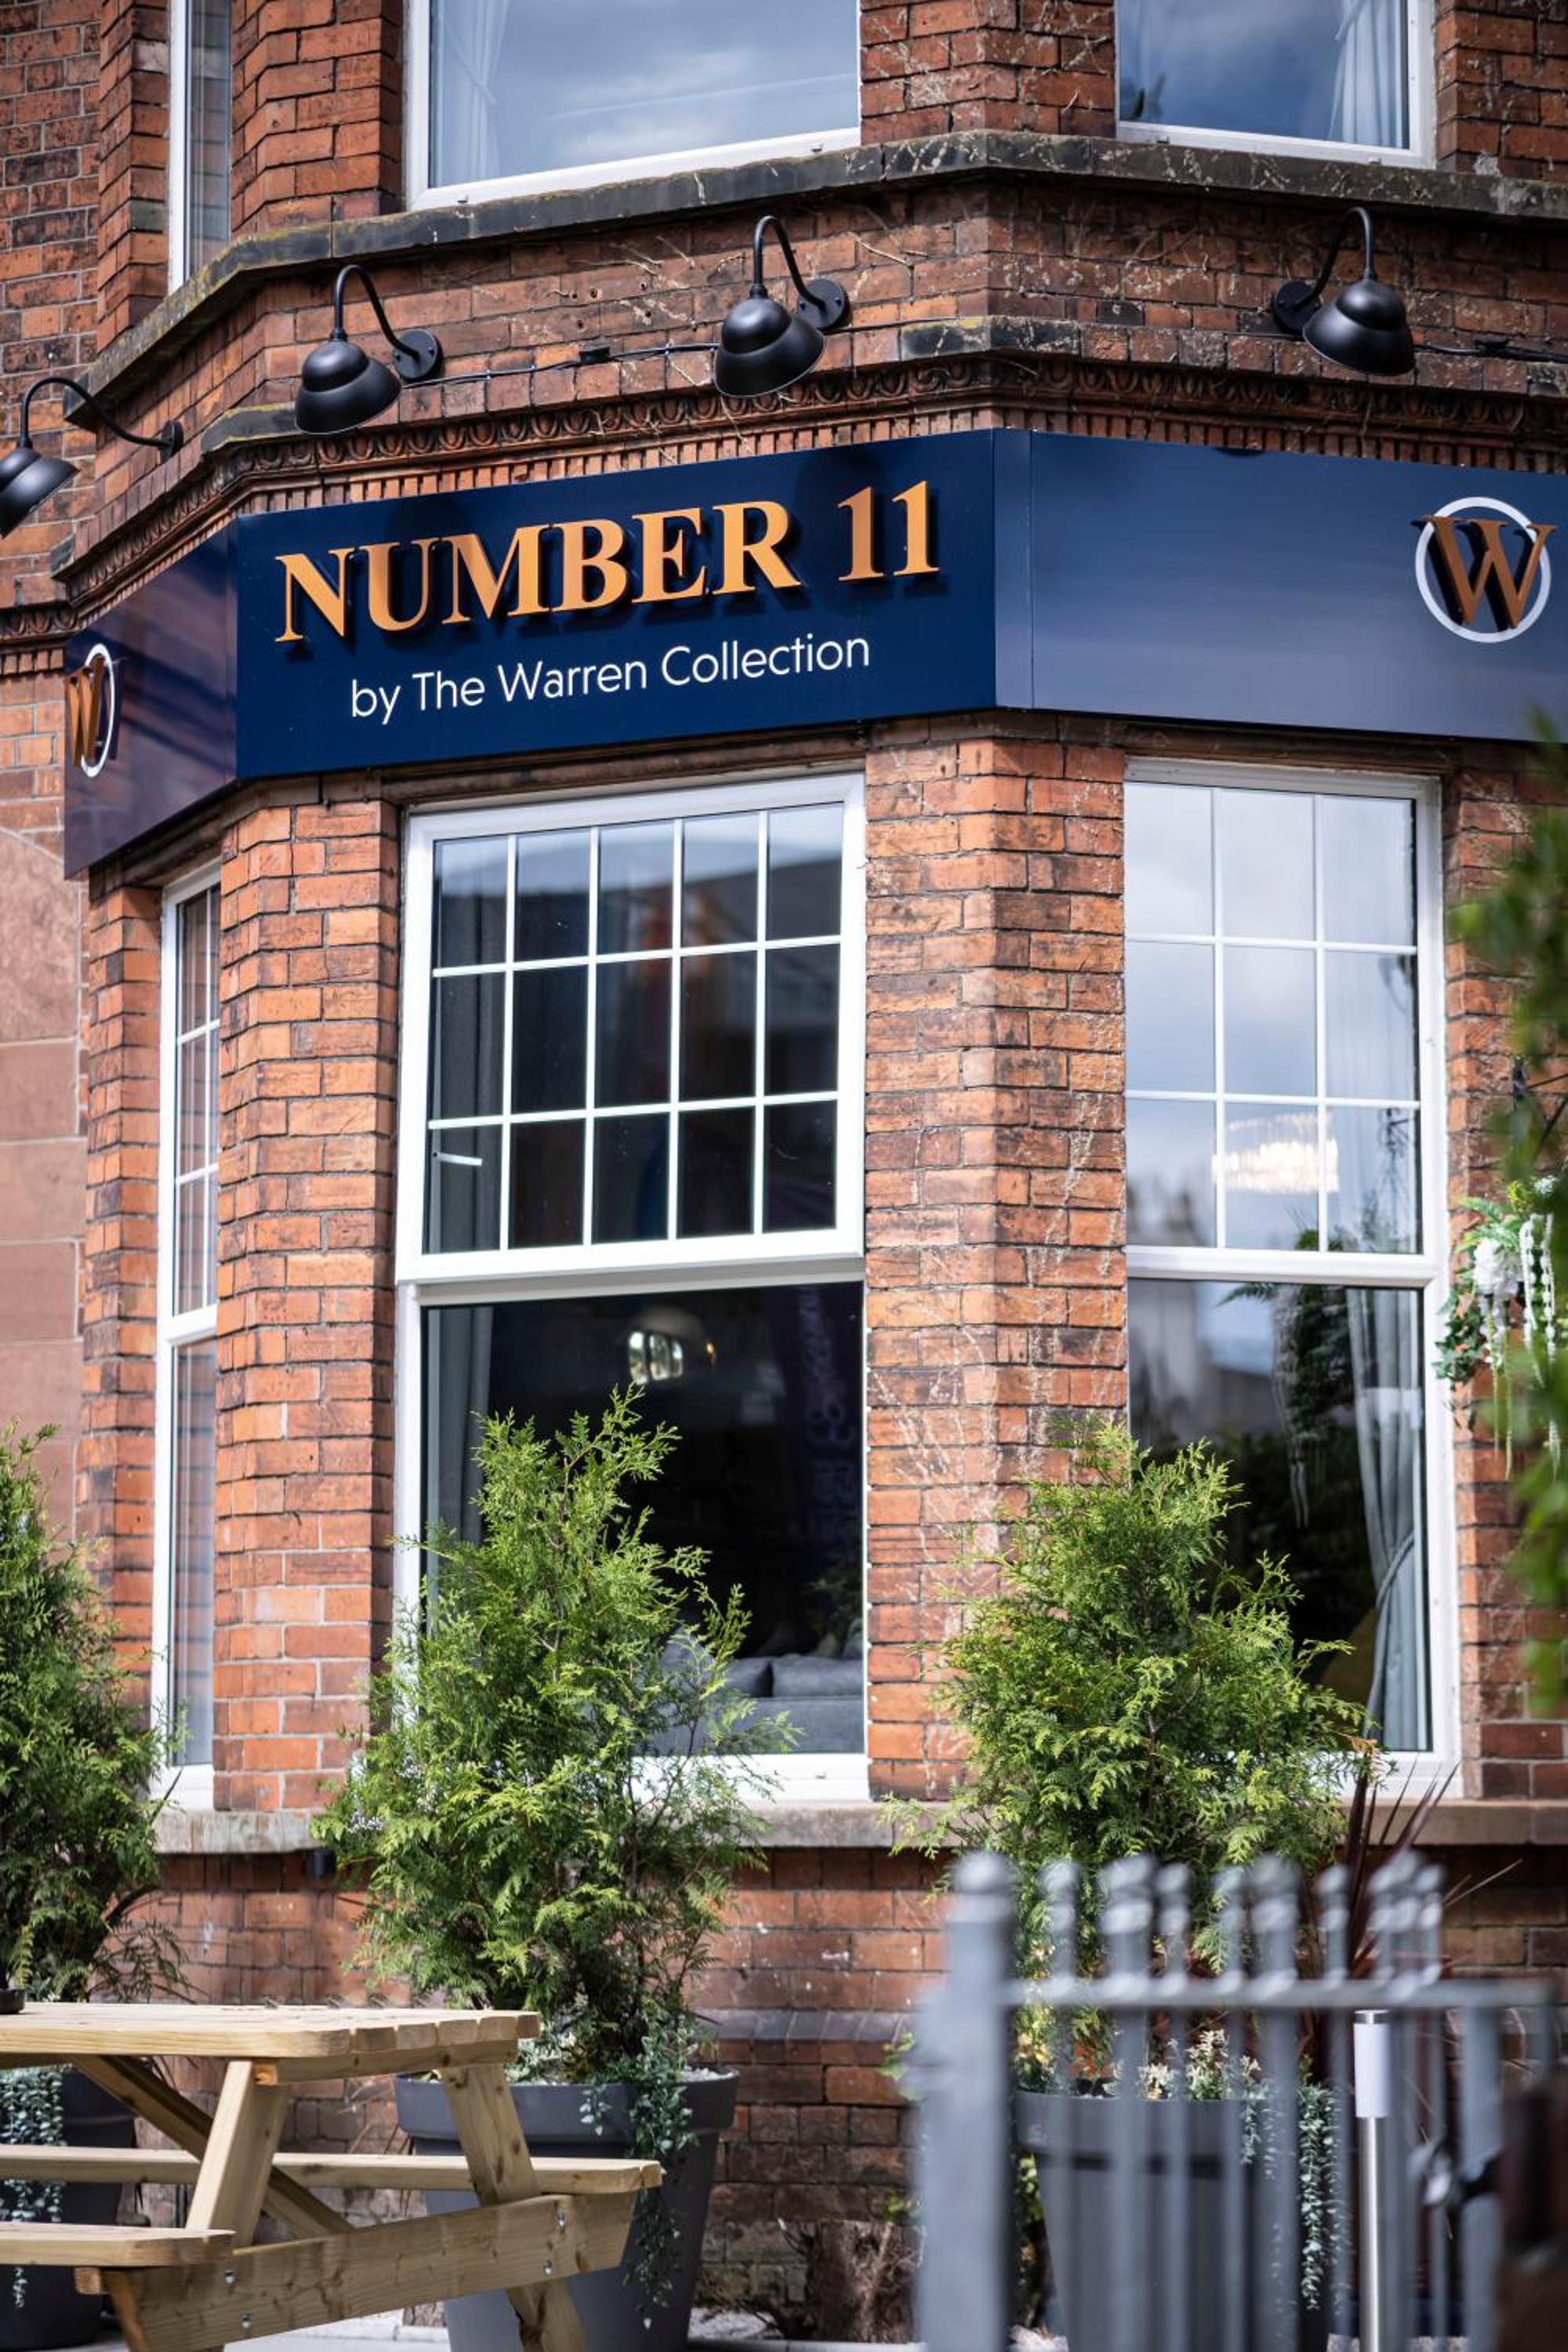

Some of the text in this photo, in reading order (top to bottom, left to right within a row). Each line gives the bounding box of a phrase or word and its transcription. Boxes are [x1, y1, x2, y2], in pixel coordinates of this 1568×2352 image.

[274, 480, 939, 644] NUMBER 11
[1416, 514, 1556, 629] W
[350, 633, 870, 725] by The Warren Collection
